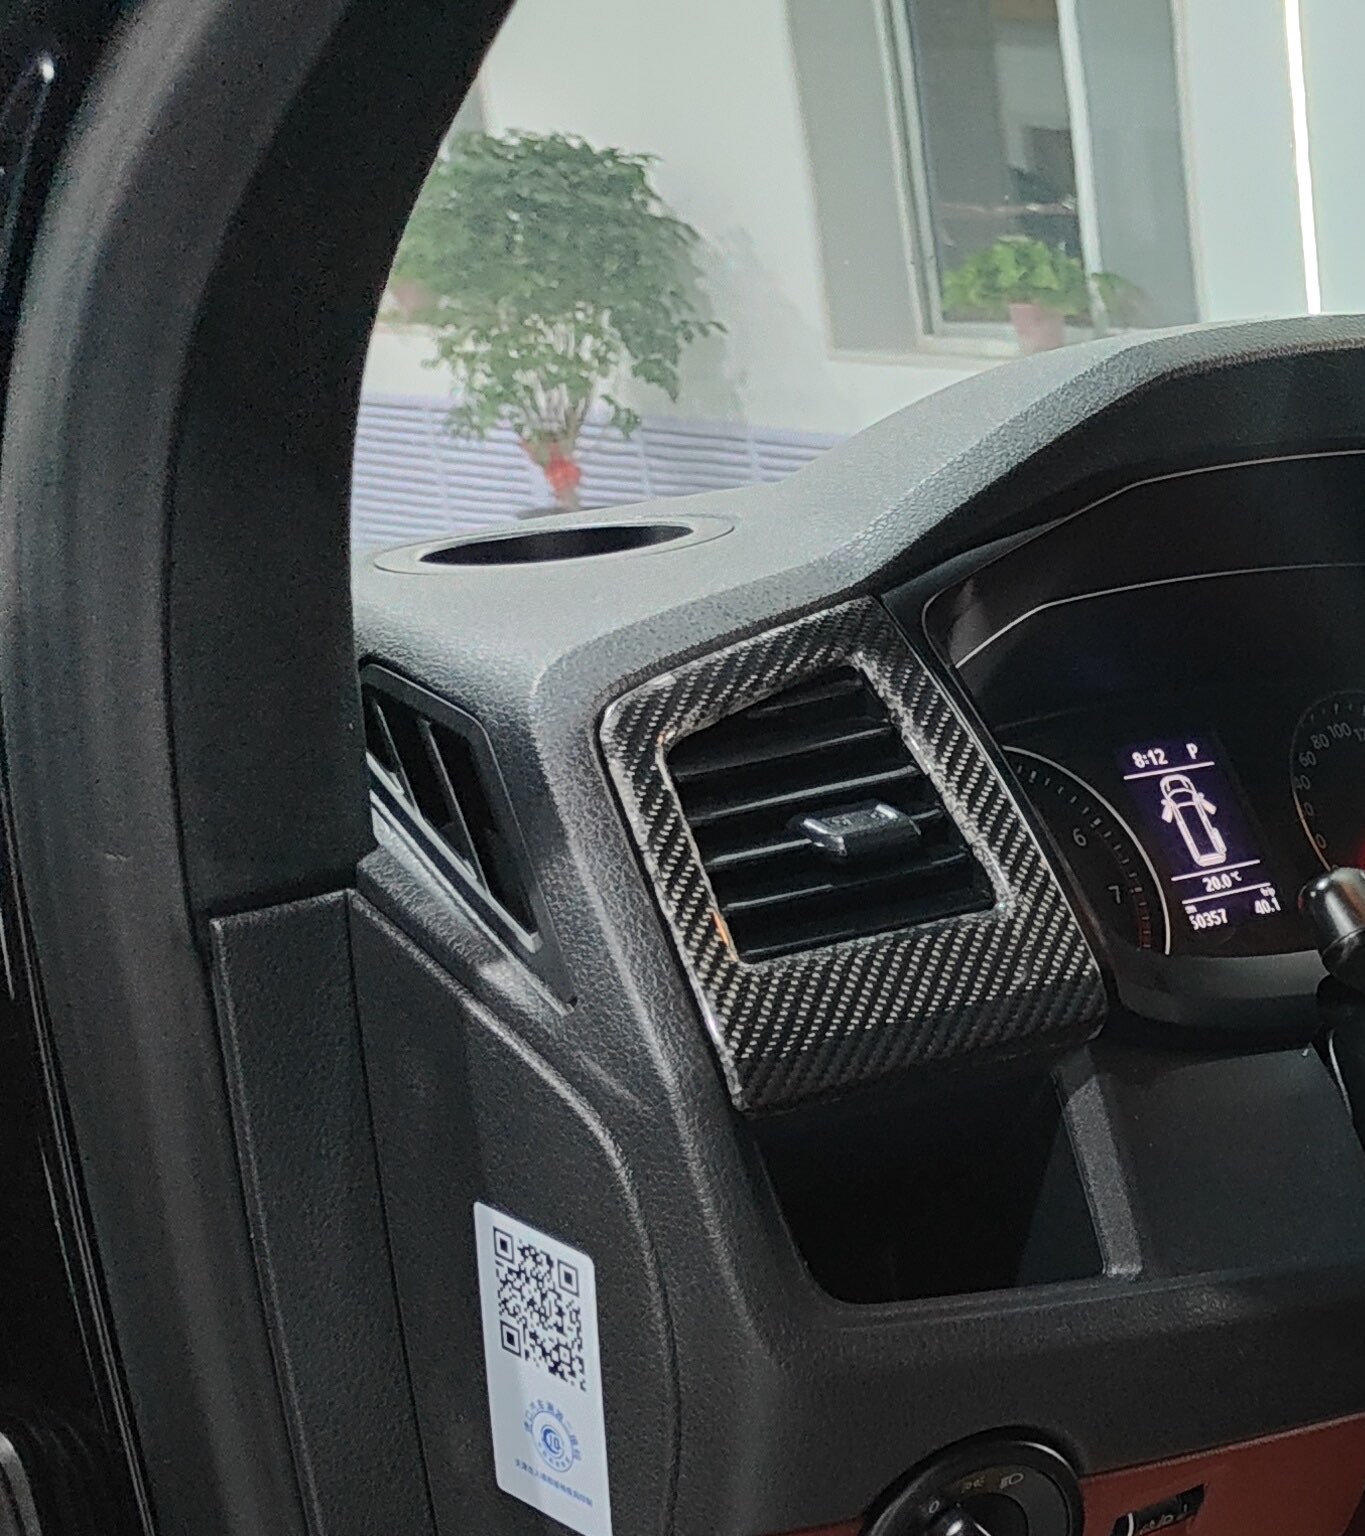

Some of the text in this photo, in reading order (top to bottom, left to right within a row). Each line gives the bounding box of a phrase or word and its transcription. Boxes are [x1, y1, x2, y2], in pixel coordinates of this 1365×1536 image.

[1327, 721, 1352, 740] 100
[1310, 733, 1331, 750] 80
[1132, 743, 1199, 769] 8:12 P
[1072, 828, 1088, 848] 6
[1108, 885, 1122, 904] 7
[1189, 897, 1281, 930] 50357 40.1
